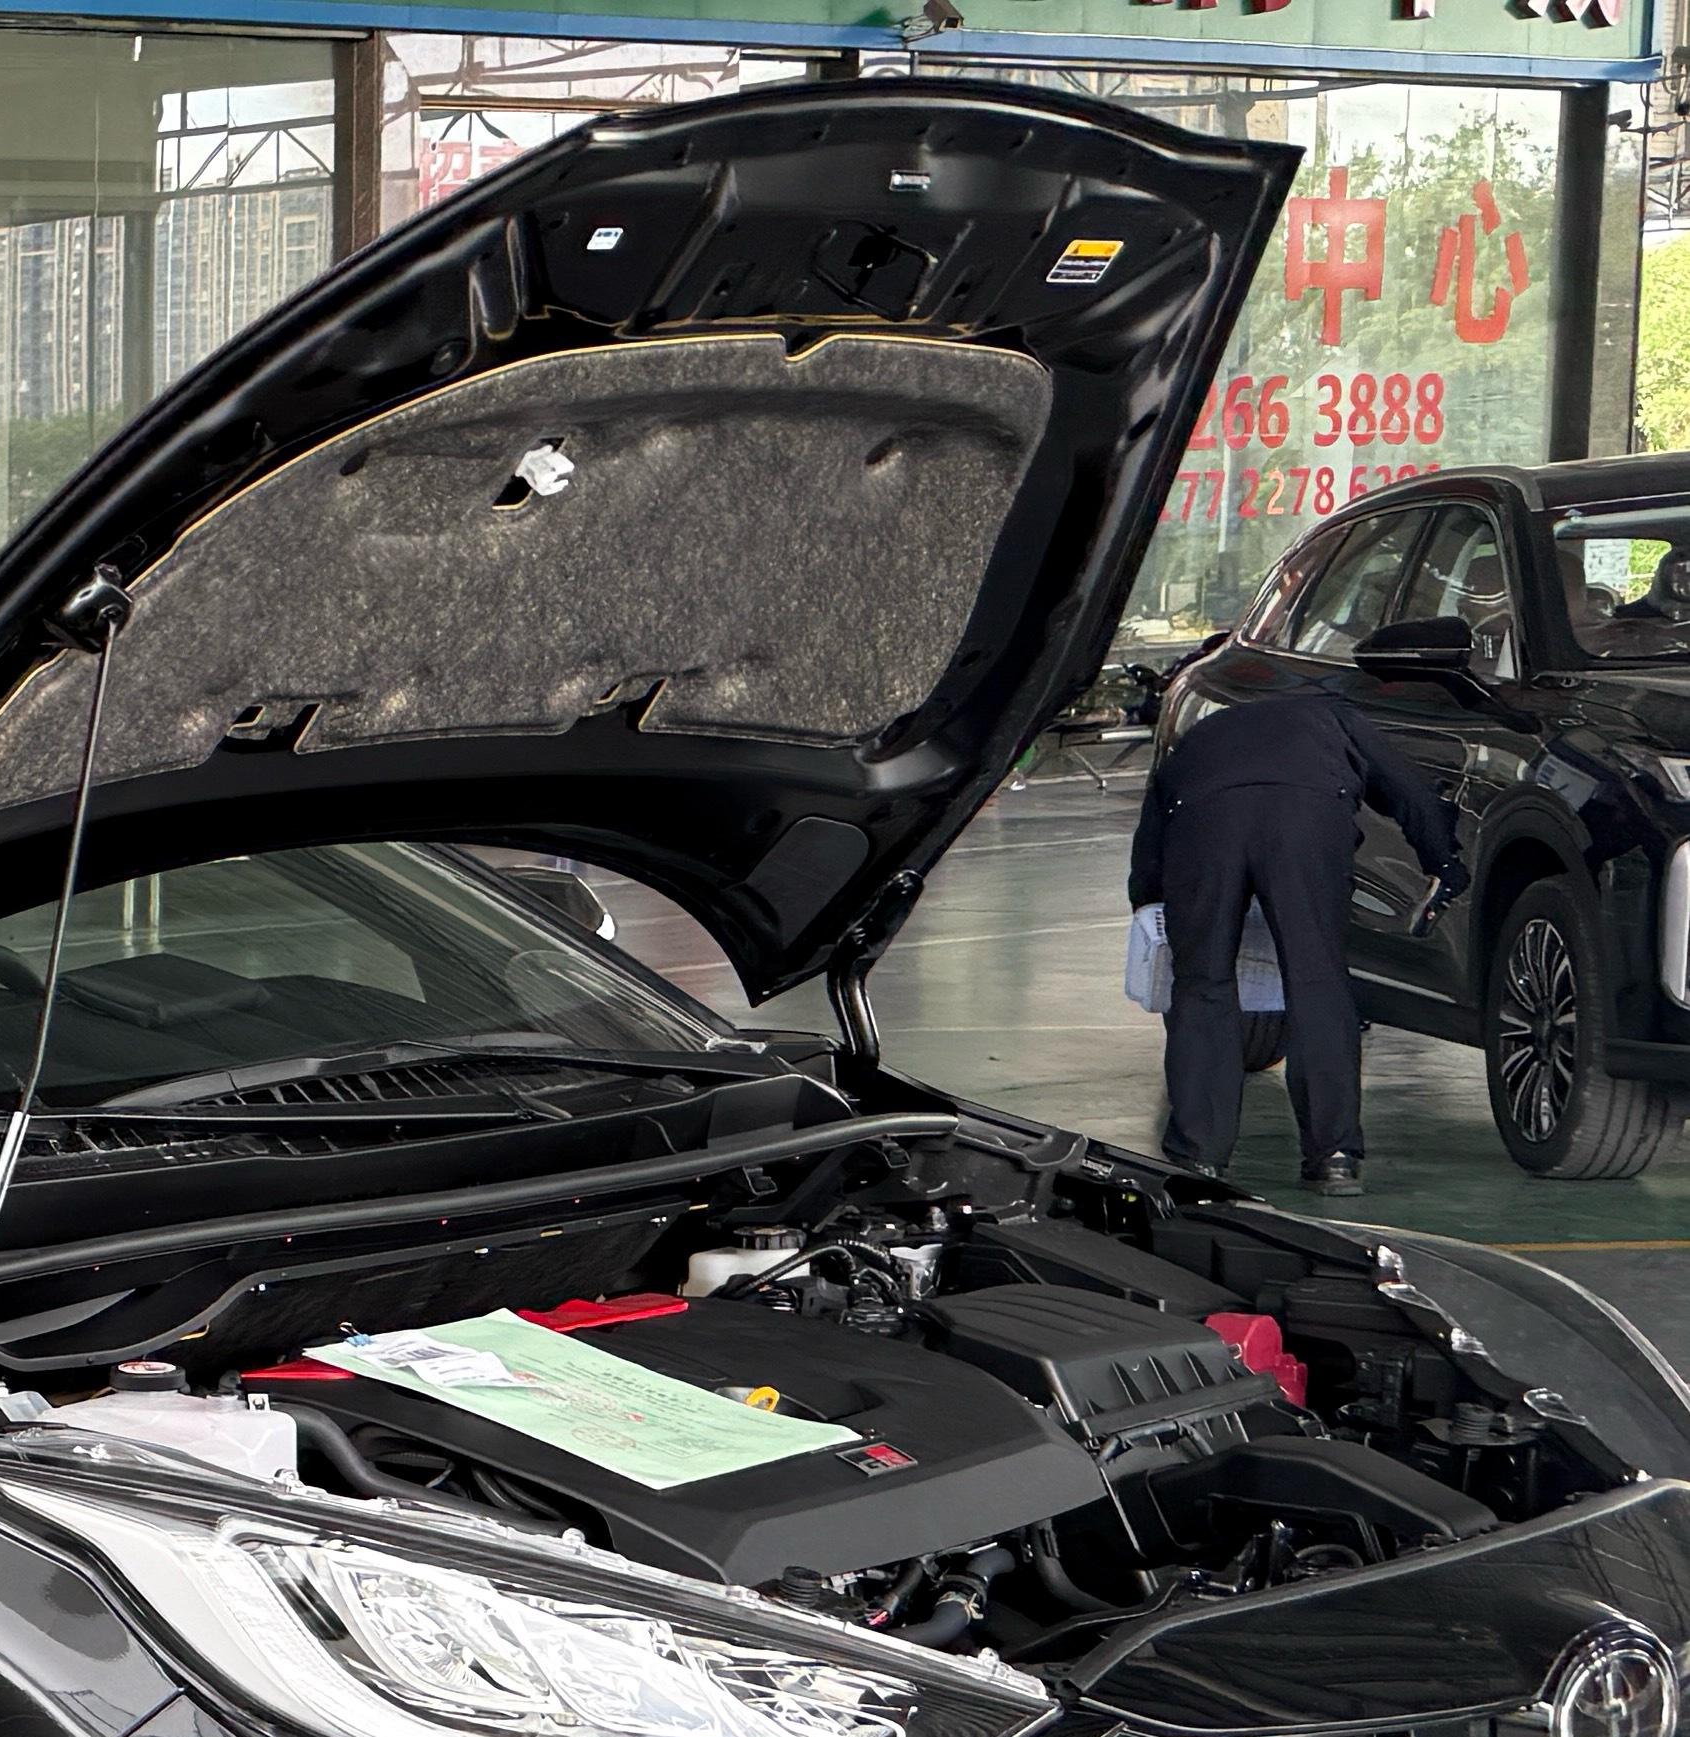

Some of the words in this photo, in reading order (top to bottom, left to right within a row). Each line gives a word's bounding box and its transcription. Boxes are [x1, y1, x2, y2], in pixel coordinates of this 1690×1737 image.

[1286, 166, 1530, 346] 中心
[1312, 372, 1445, 447] 3888
[1239, 465, 1335, 520] 2278
